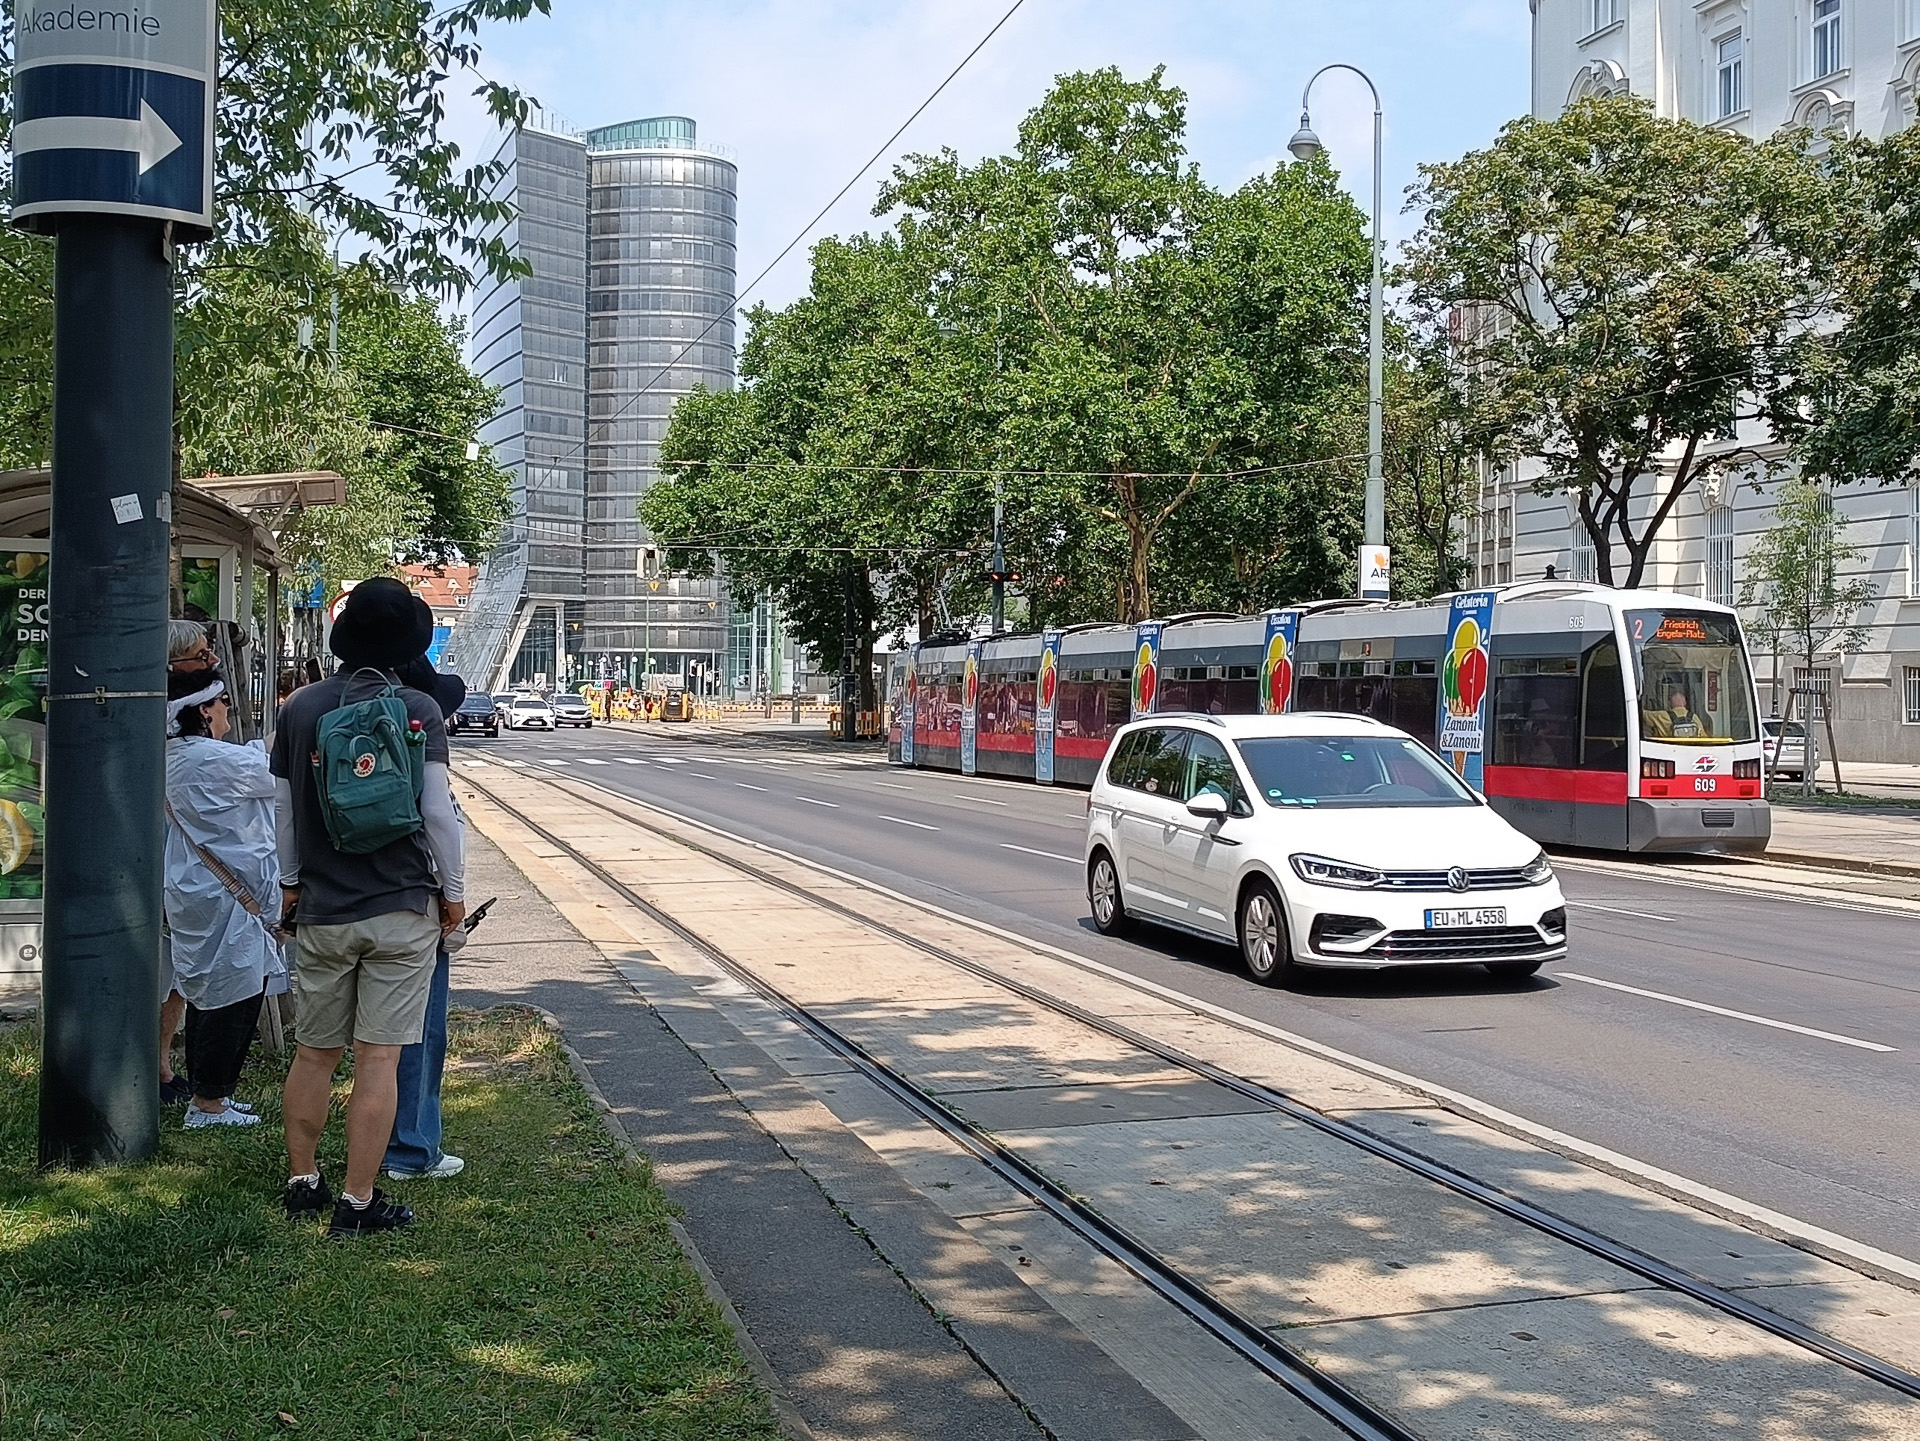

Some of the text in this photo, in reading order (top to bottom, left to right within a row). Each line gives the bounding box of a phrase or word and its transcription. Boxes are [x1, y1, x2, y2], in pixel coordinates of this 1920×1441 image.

[21, 3, 160, 36] Akademie
[18, 588, 46, 599] DER
[1568, 616, 1584, 628] 609
[1634, 619, 1643, 639] 2
[1663, 620, 1699, 629] Friedrich
[1656, 630, 1706, 640] Engels-Platz
[1445, 716, 1478, 731] Zanoni
[1694, 777, 1716, 792] 609
[1433, 912, 1449, 926] EU
[1458, 911, 1473, 925] ML
[1475, 910, 1504, 924] 4558
